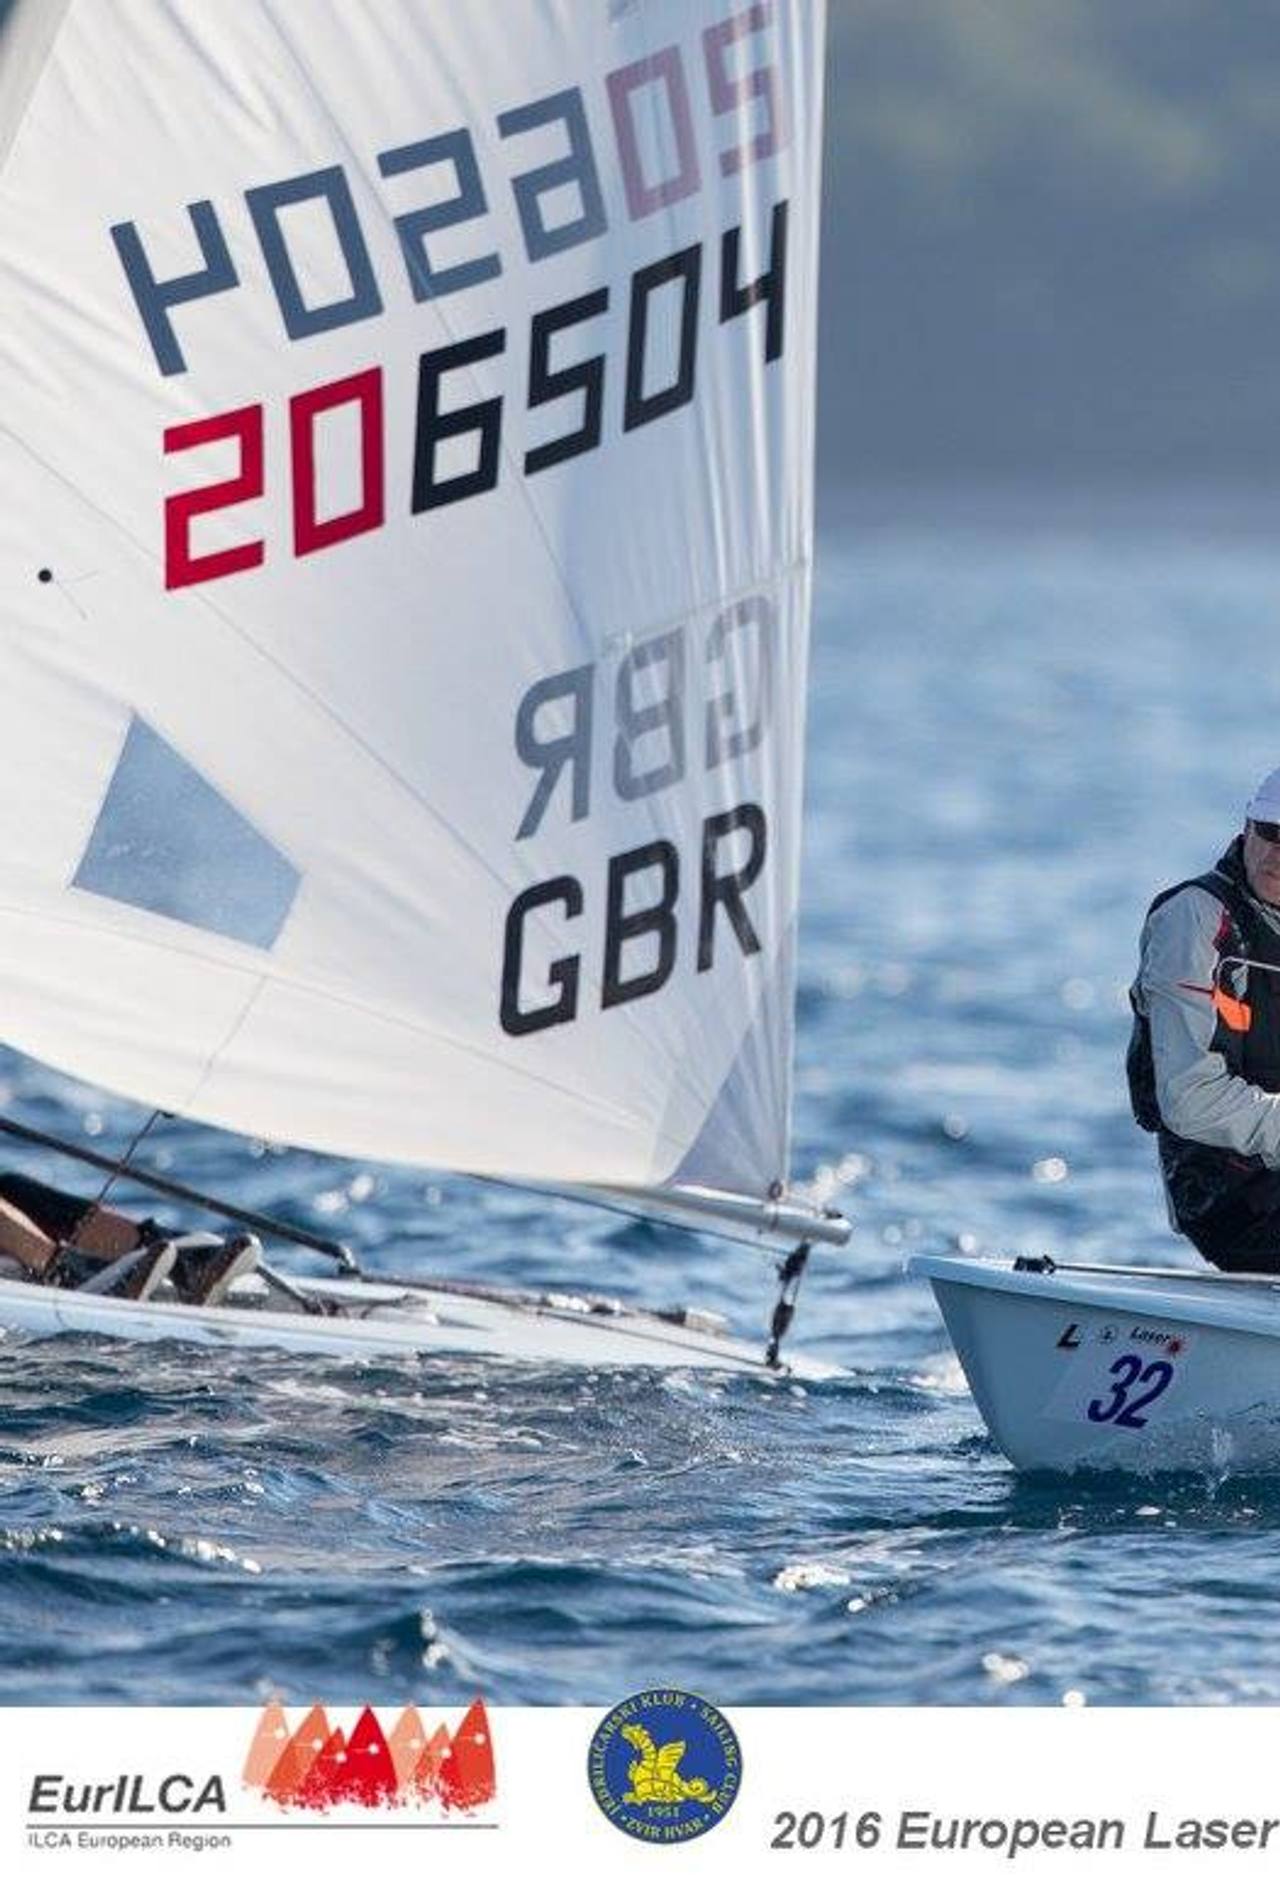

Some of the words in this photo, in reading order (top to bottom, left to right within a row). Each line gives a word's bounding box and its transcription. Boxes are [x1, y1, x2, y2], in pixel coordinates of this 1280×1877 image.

[163, 200, 788, 592] 206504
[500, 803, 768, 1037] GBR
[1087, 1354, 1174, 1429] 32
